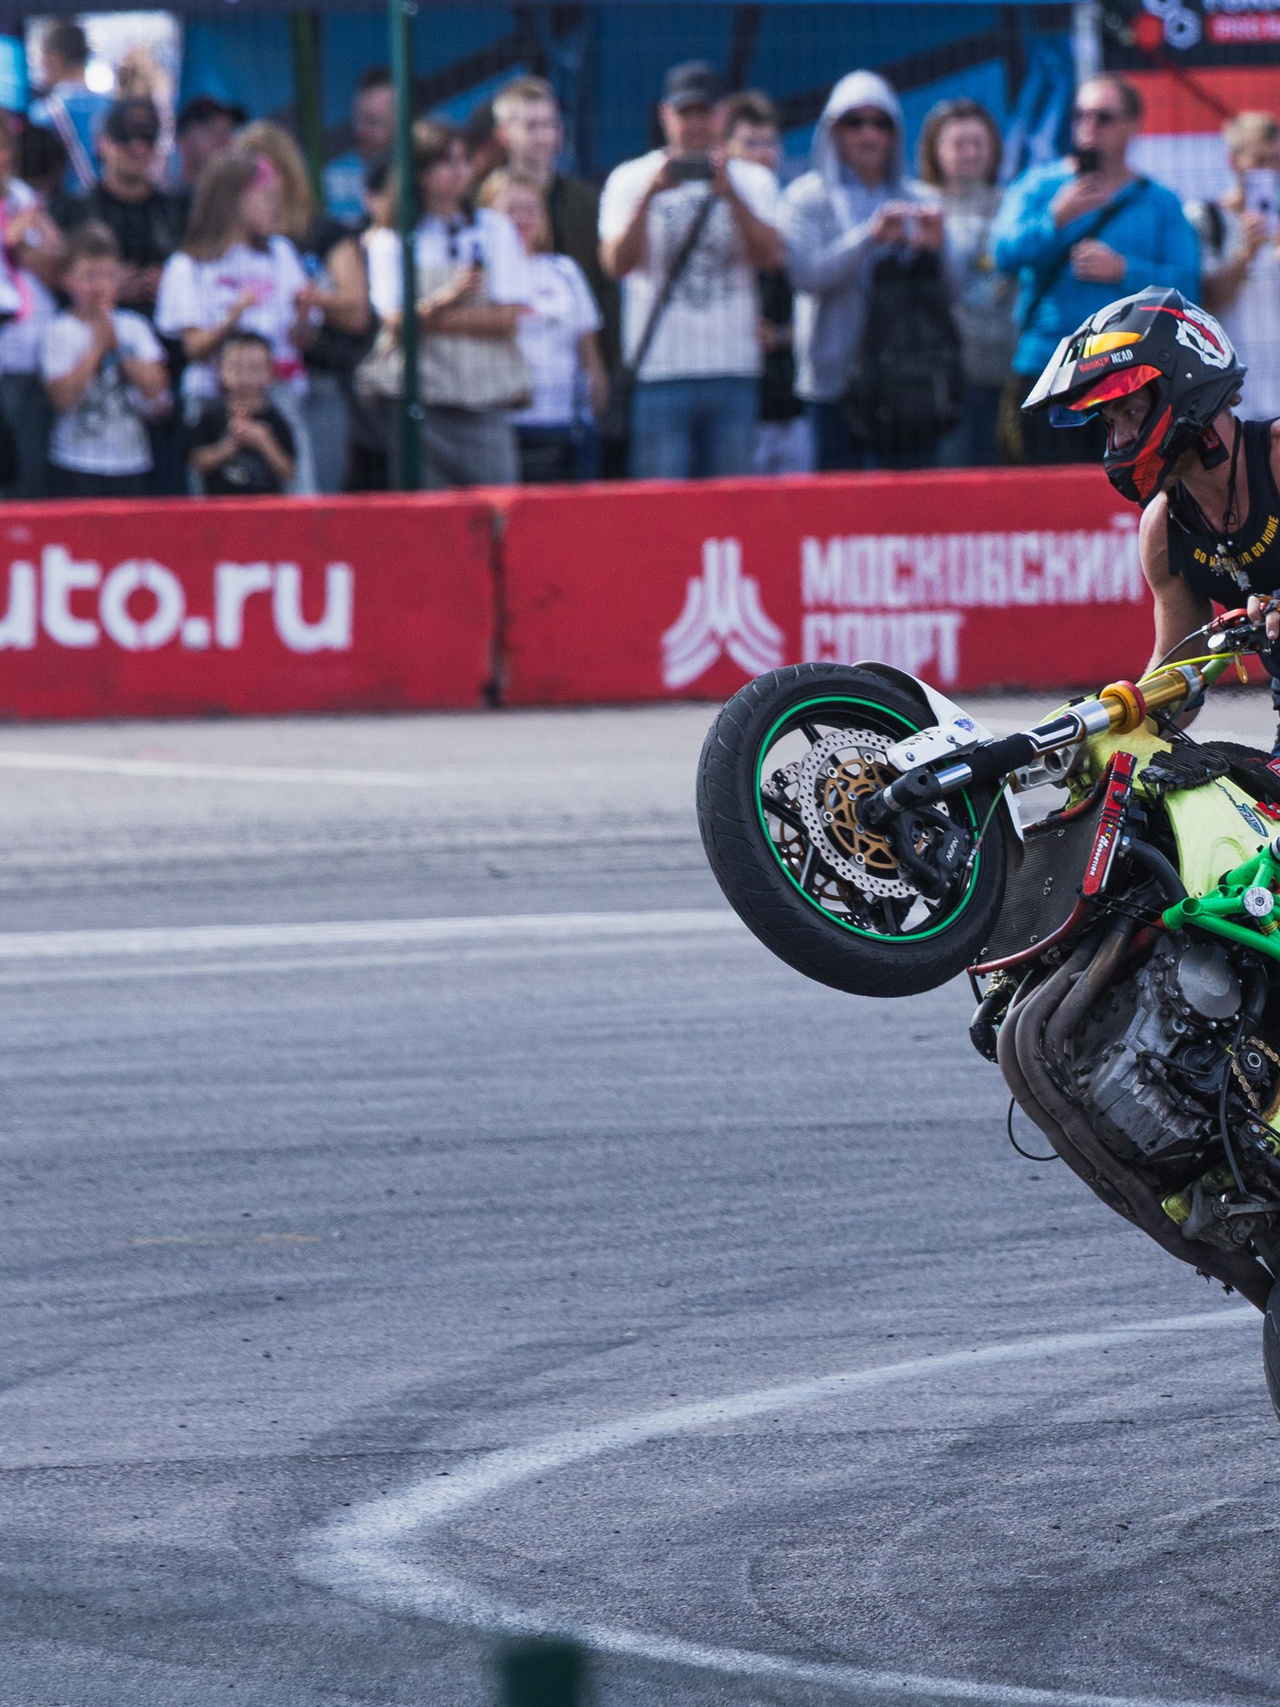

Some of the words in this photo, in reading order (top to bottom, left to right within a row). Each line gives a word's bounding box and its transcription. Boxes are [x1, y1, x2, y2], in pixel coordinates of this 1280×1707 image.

[1079, 356, 1110, 373] BROKEN
[1111, 349, 1133, 364] HEAD
[803, 513, 1145, 607] МОСКОВСКИЙ
[1193, 548, 1207, 564] GO
[1250, 542, 1265, 557] GO
[1261, 515, 1279, 545] HOME
